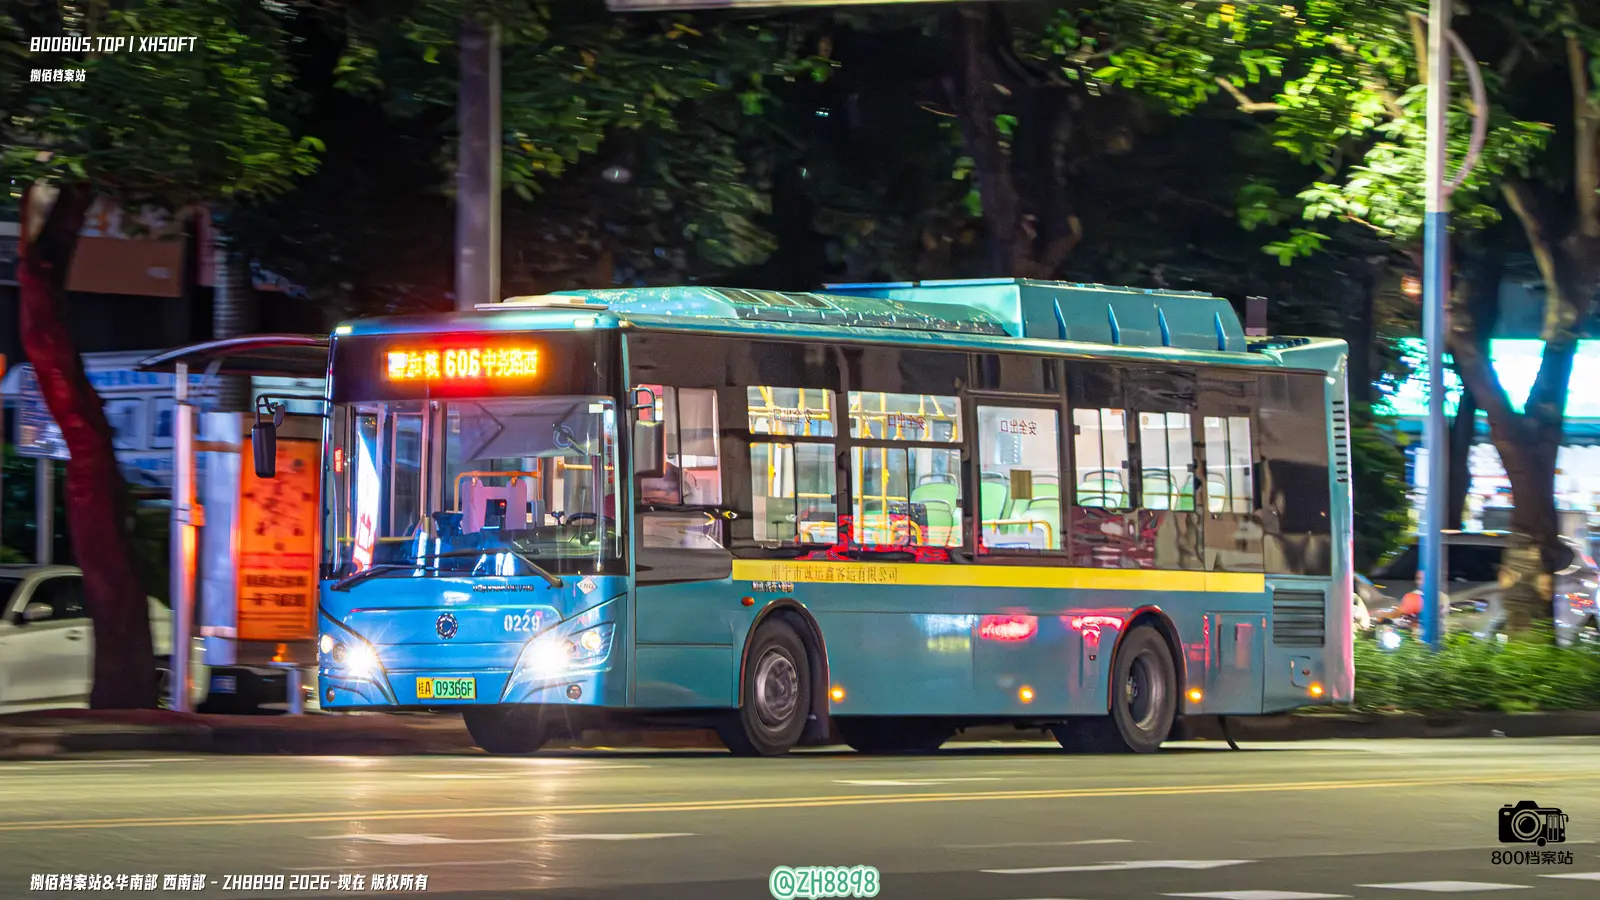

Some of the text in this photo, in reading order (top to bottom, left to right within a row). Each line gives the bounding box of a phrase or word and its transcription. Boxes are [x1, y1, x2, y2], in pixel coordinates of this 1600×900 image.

[445, 348, 481, 378] 606
[504, 614, 541, 632] 0229
[435, 680, 473, 697] 09366F
